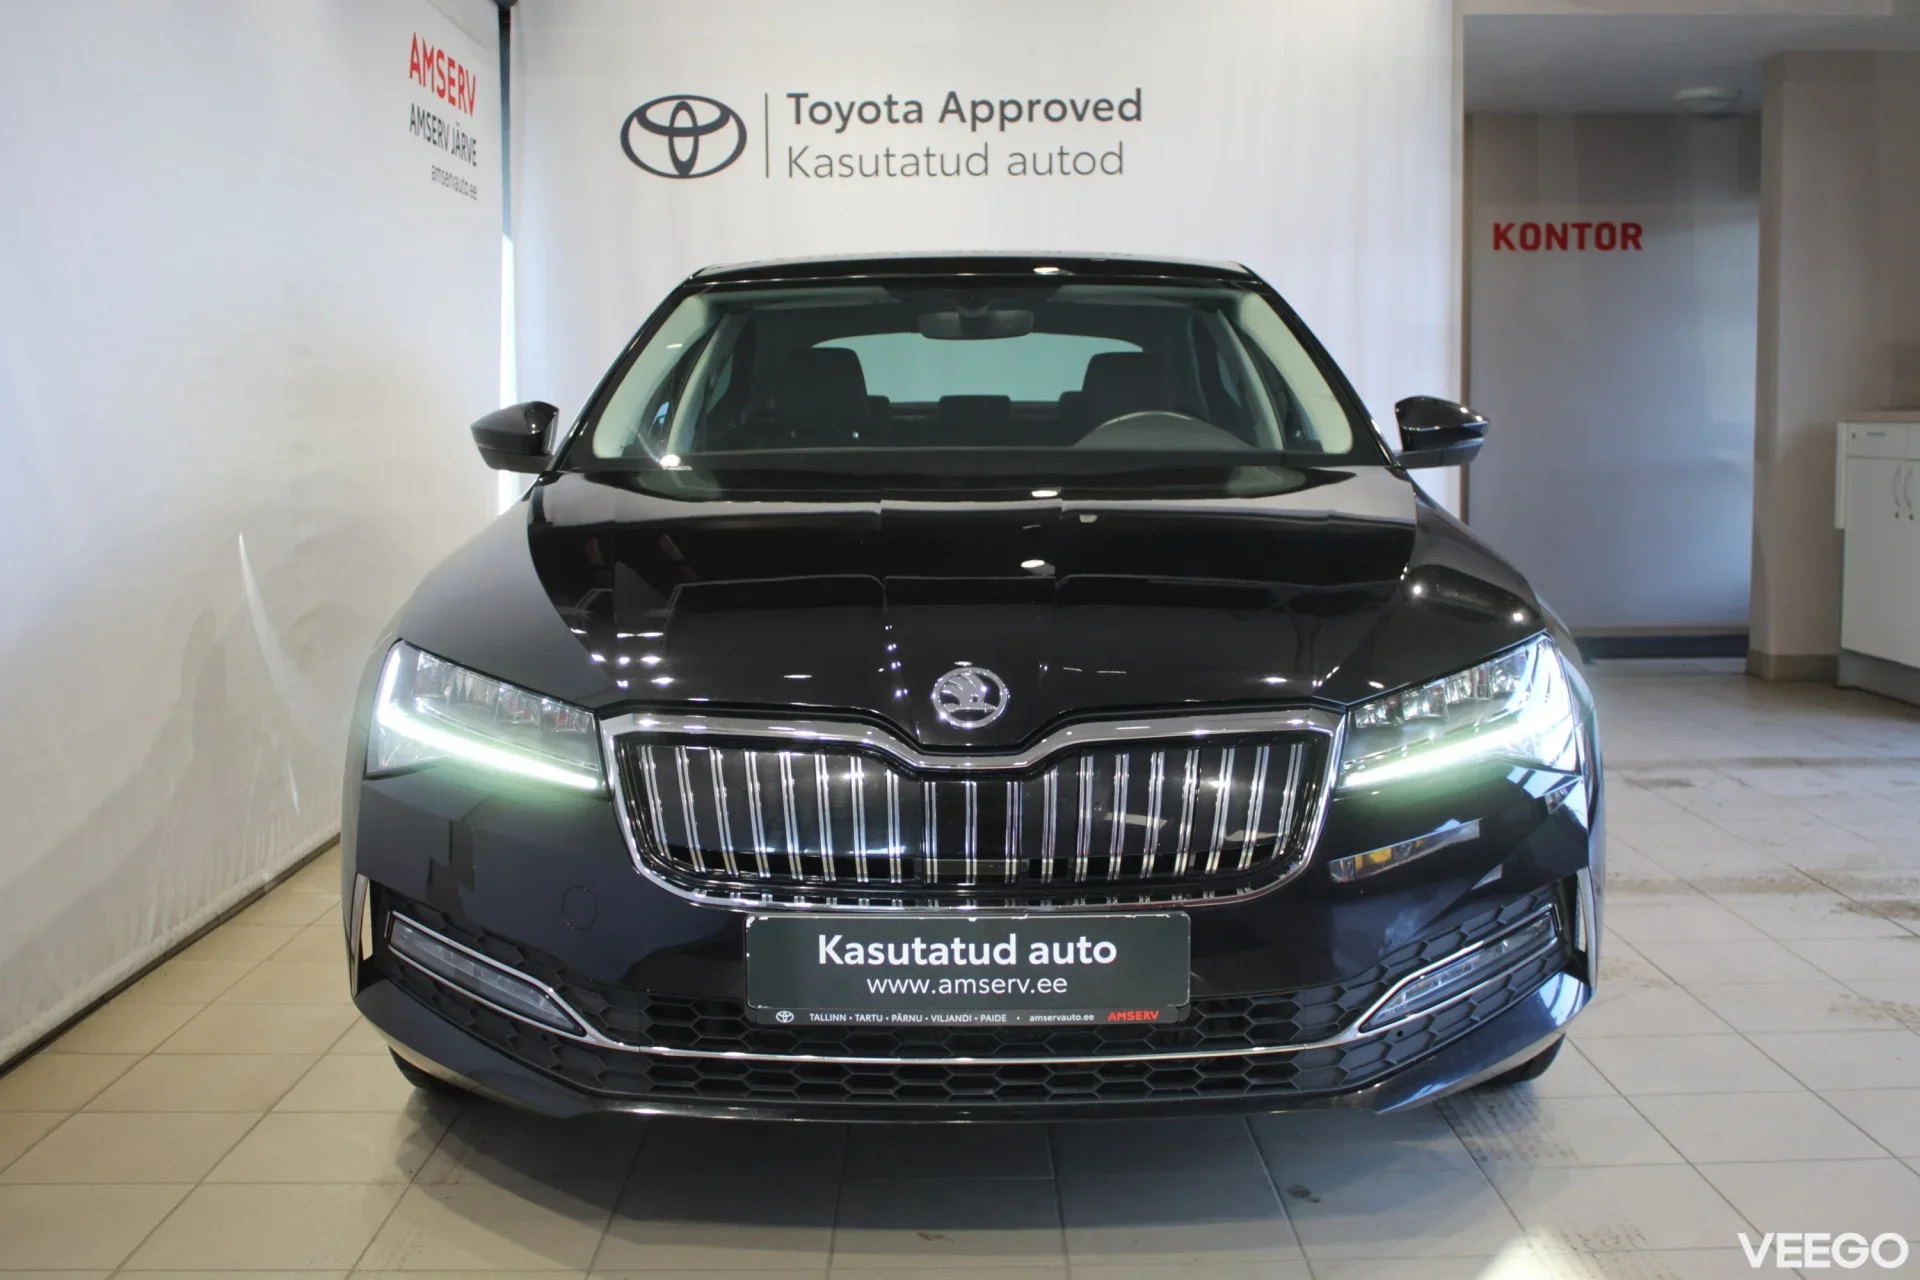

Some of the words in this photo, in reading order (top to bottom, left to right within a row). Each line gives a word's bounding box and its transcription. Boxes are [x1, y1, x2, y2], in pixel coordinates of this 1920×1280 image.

[409, 31, 477, 118] AMSERV
[786, 92, 924, 134] Toyota
[938, 87, 1143, 133] Approved
[409, 102, 450, 152] AMSERV
[450, 120, 477, 167] JÄRVE
[787, 141, 989, 178] Kasutatud
[1006, 140, 1124, 177] autod
[431, 164, 478, 201] amservauto.ee
[1493, 222, 1643, 251] KONTOR
[818, 932, 1017, 966] Kasutatud
[1028, 934, 1118, 965] auto
[866, 974, 1068, 995] www.amserv.ee
[809, 1013, 847, 1022] TALLINN
[855, 1013, 883, 1023] TARTU
[891, 1012, 923, 1023] PÄRNU
[930, 1013, 972, 1023] VILJANDI
[980, 1013, 1007, 1023] PAIDE
[1029, 1012, 1095, 1022] amservauto.ee
[1107, 1010, 1160, 1022] AMSERV
